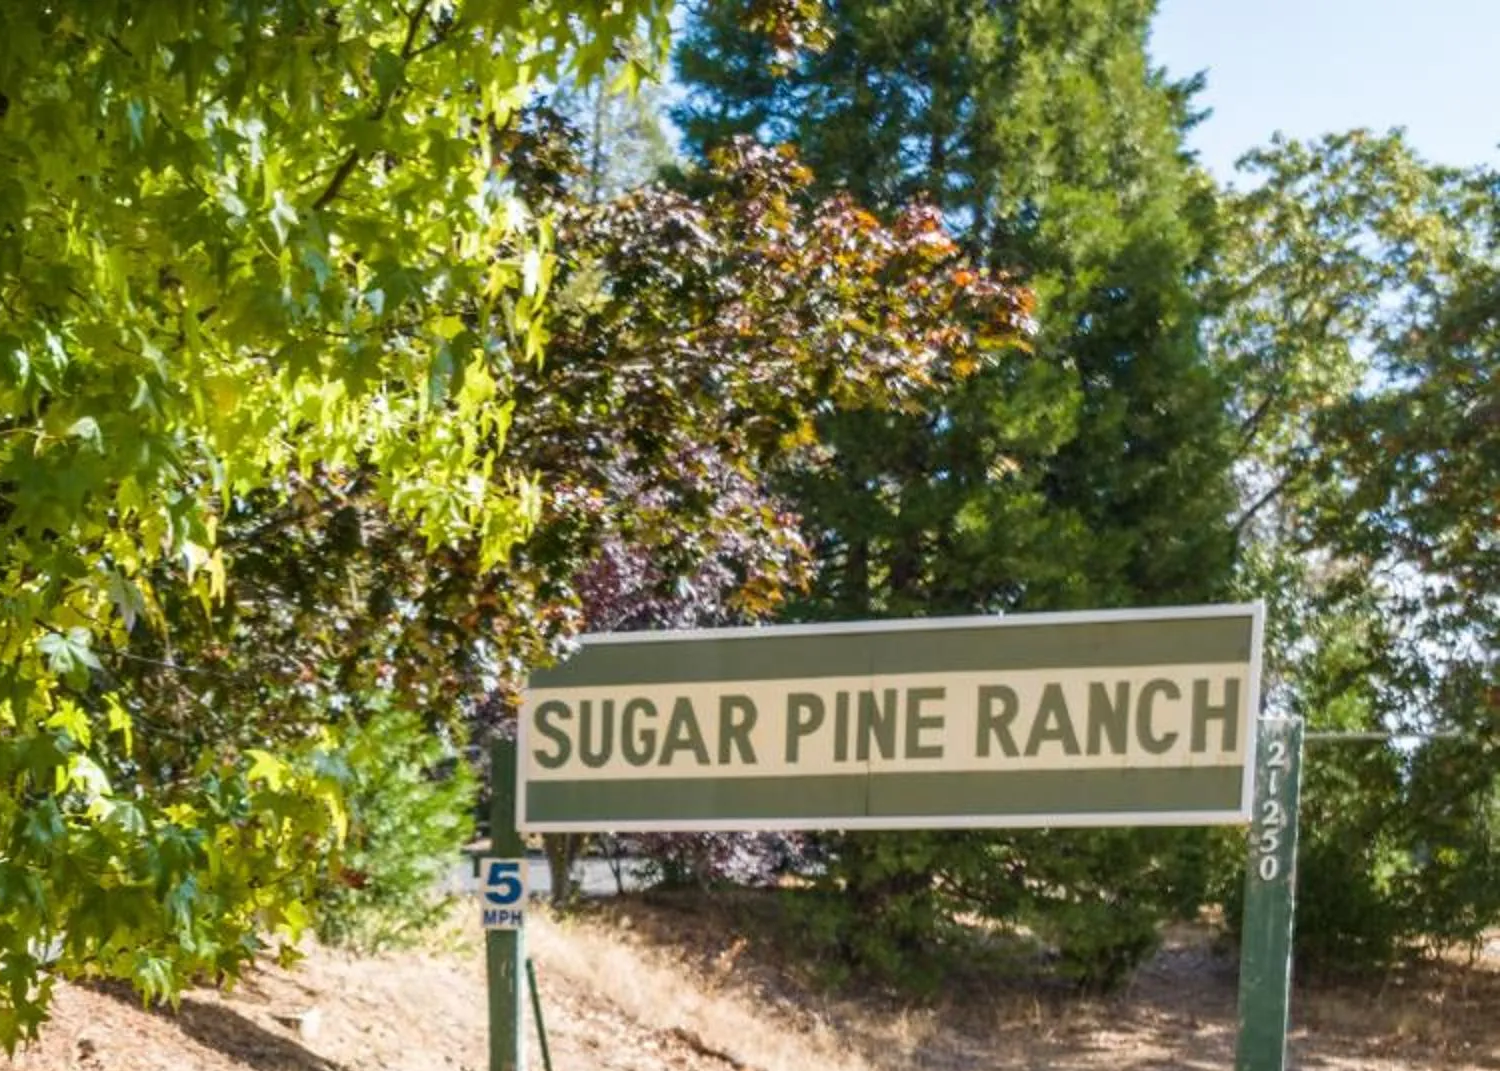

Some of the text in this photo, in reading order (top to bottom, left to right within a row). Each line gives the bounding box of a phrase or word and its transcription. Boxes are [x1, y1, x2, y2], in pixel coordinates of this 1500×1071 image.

[532, 677, 1241, 770] SUGAR PINE RANCH
[1259, 741, 1287, 881] 21250
[484, 862, 522, 904] 5
[483, 910, 522, 925] MPH
